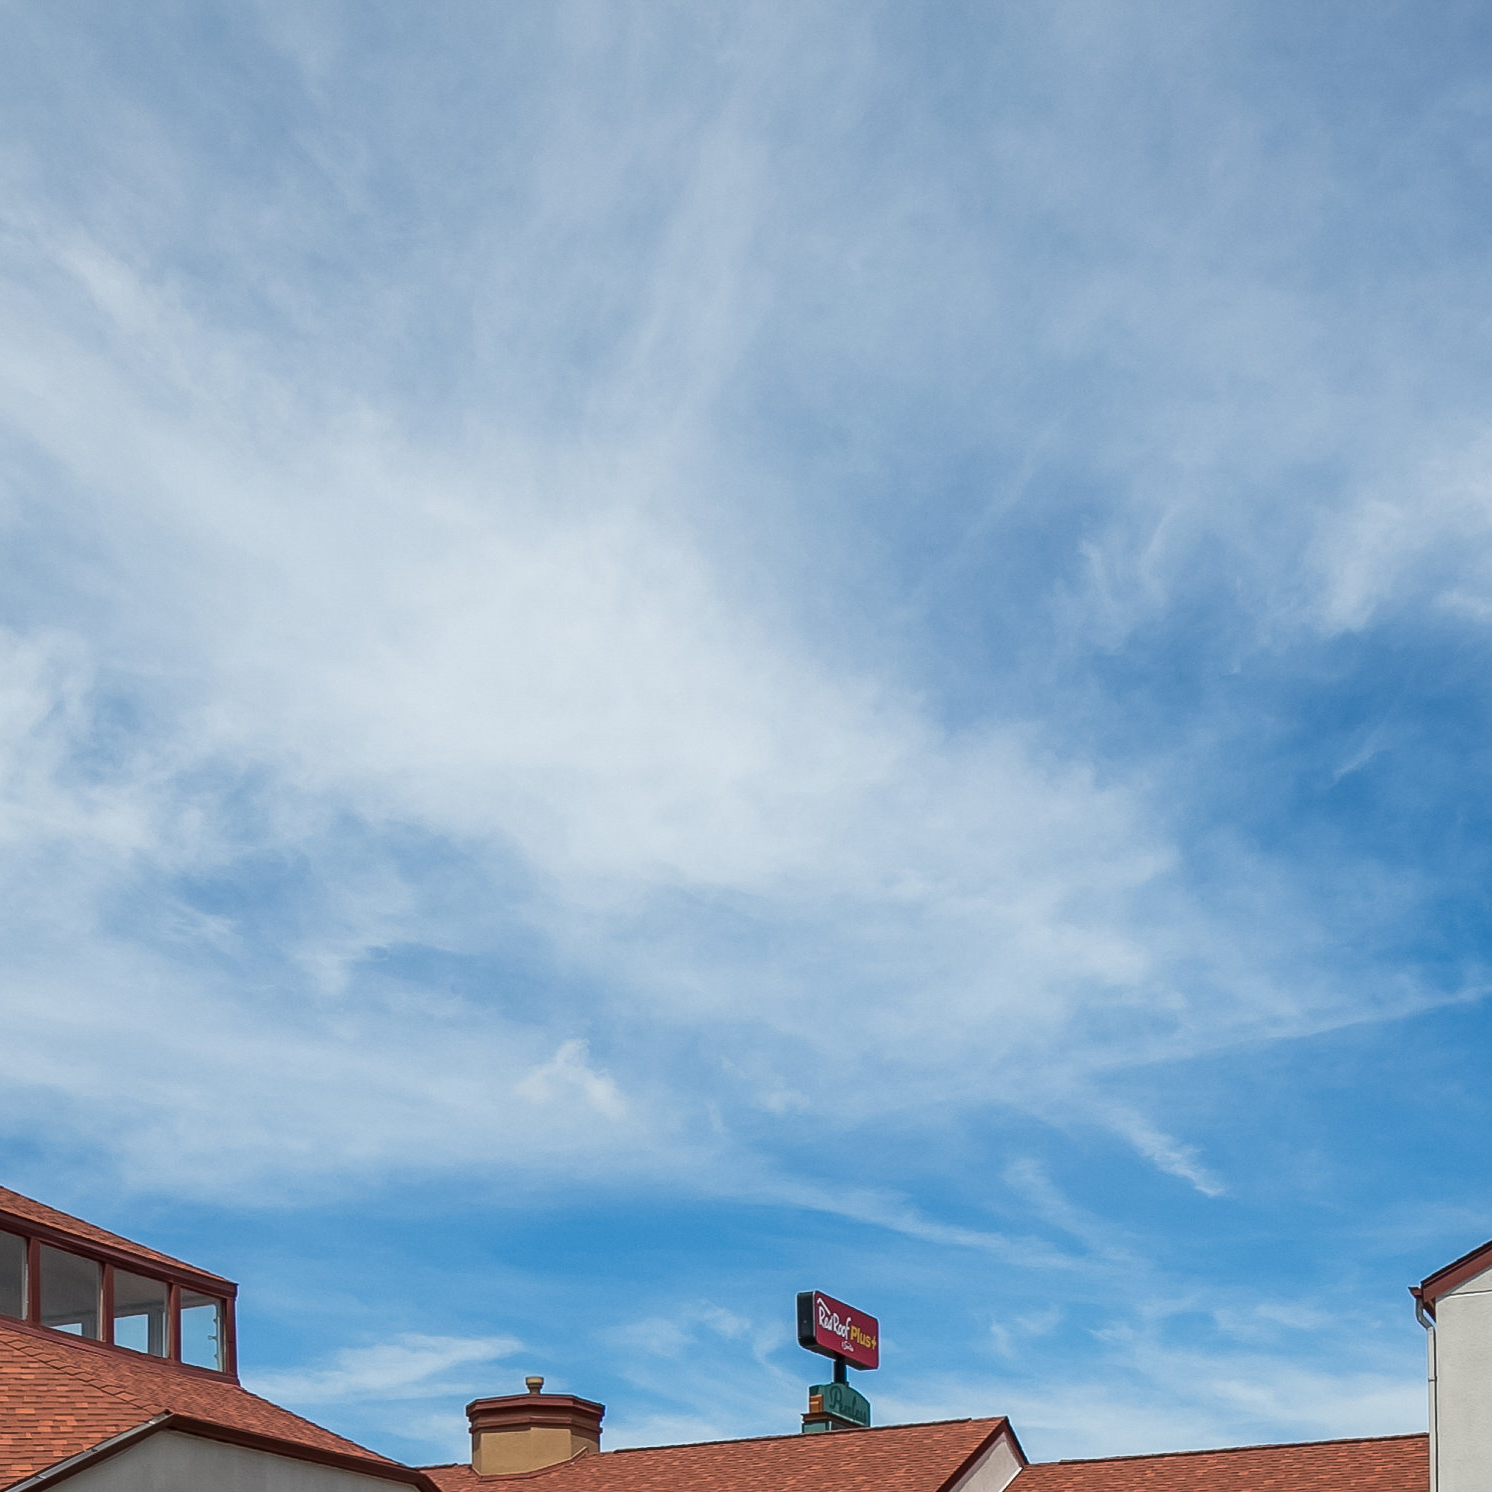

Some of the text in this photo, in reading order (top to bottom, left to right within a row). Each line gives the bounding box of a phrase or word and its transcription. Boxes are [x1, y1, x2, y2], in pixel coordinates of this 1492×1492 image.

[818, 1306, 833, 1331] Red
[833, 1313, 851, 1340] Roof
[850, 1325, 877, 1350] Plus+
